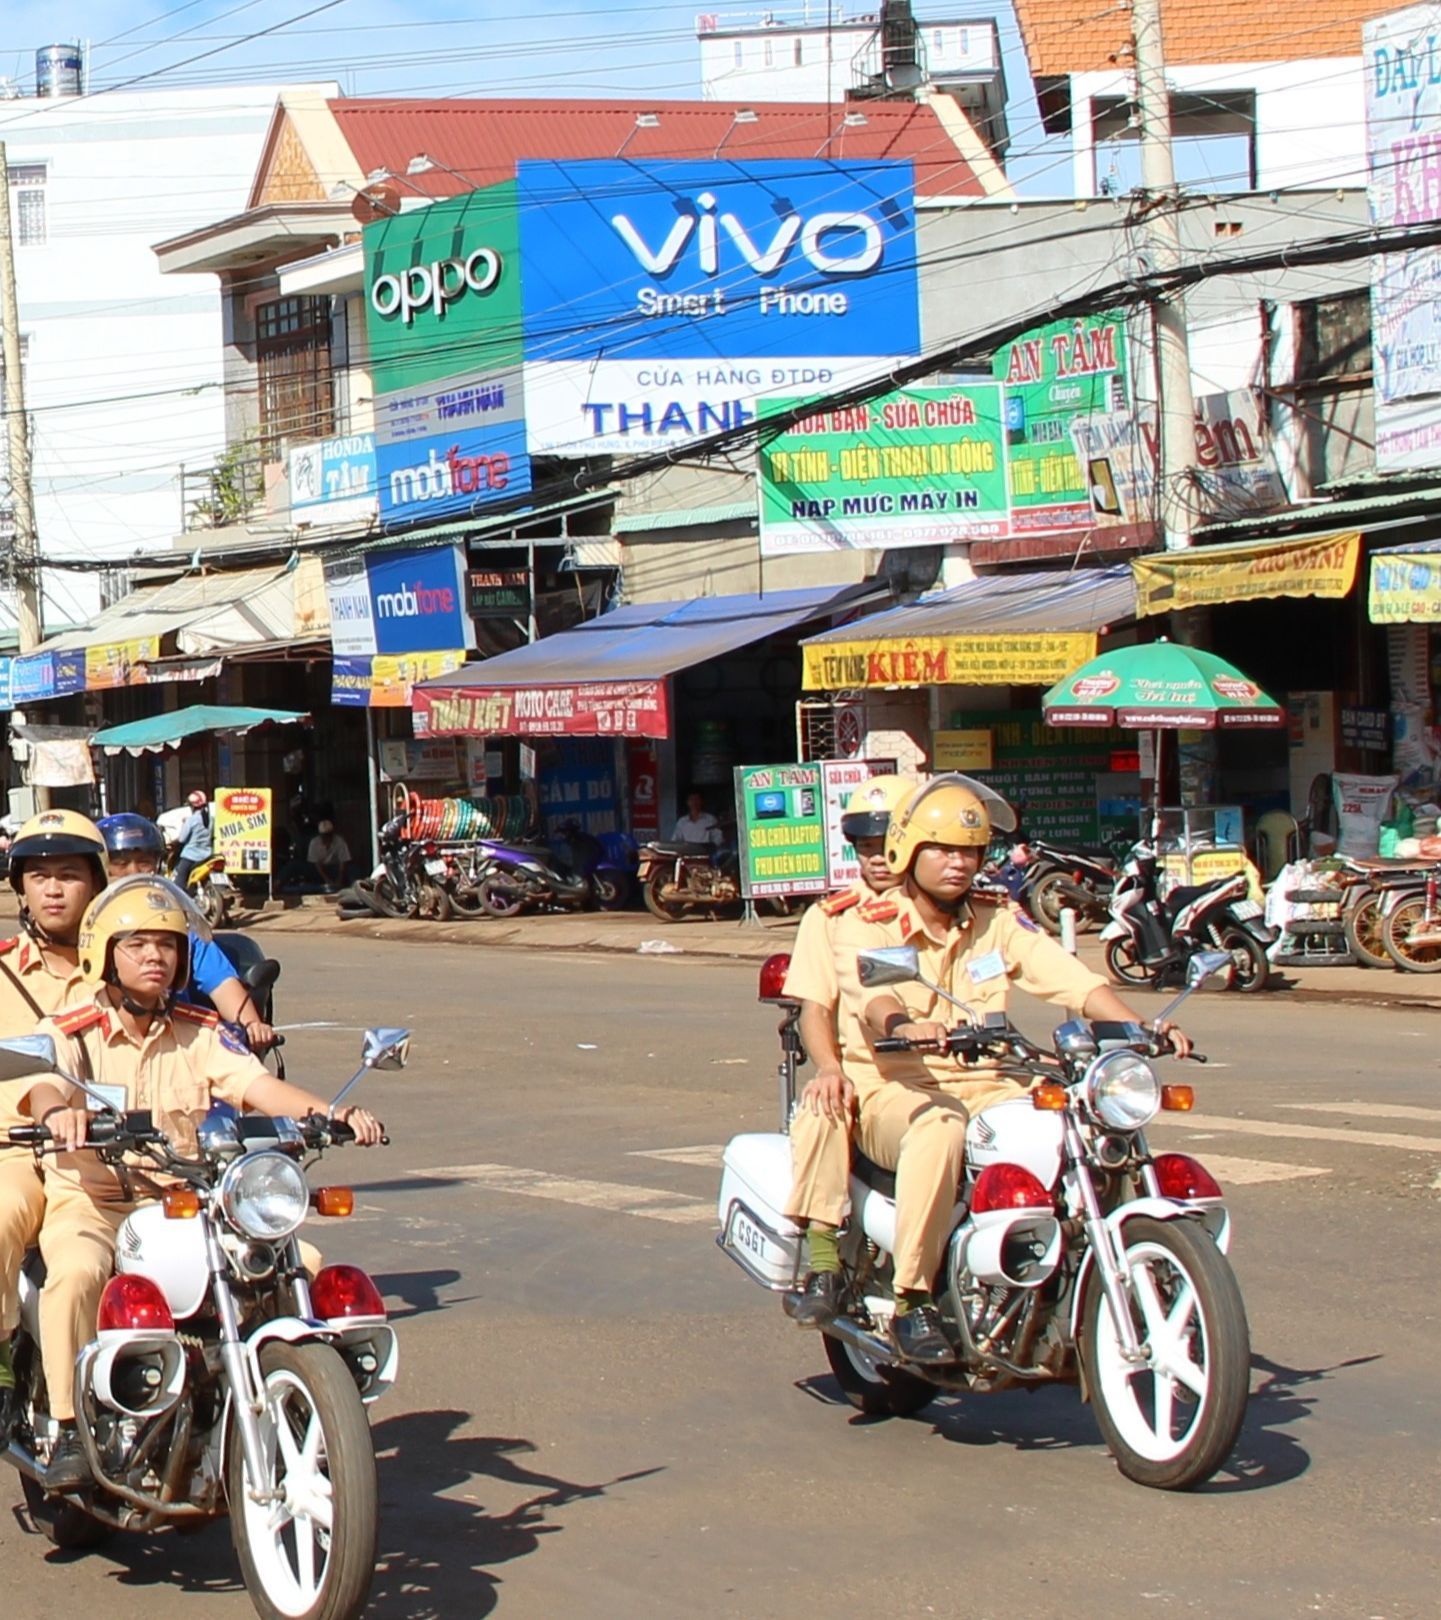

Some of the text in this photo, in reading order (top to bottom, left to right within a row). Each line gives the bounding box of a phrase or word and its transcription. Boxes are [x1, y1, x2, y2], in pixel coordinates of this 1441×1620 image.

[612, 192, 883, 275] vivo
[371, 247, 502, 324] oppo
[637, 285, 849, 317] Smart Phone
[1006, 320, 1117, 385] AN TÂM
[322, 434, 374, 460] HONDA
[390, 444, 510, 507] mobifone
[955, 489, 979, 508] IN
[377, 581, 455, 619] mobifone
[515, 690, 545, 718] MOTO
[545, 689, 574, 718] CARE
[749, 771, 773, 788] AN
[220, 813, 268, 838] MUA SIM
[738, 1219, 766, 1258] CSGT
